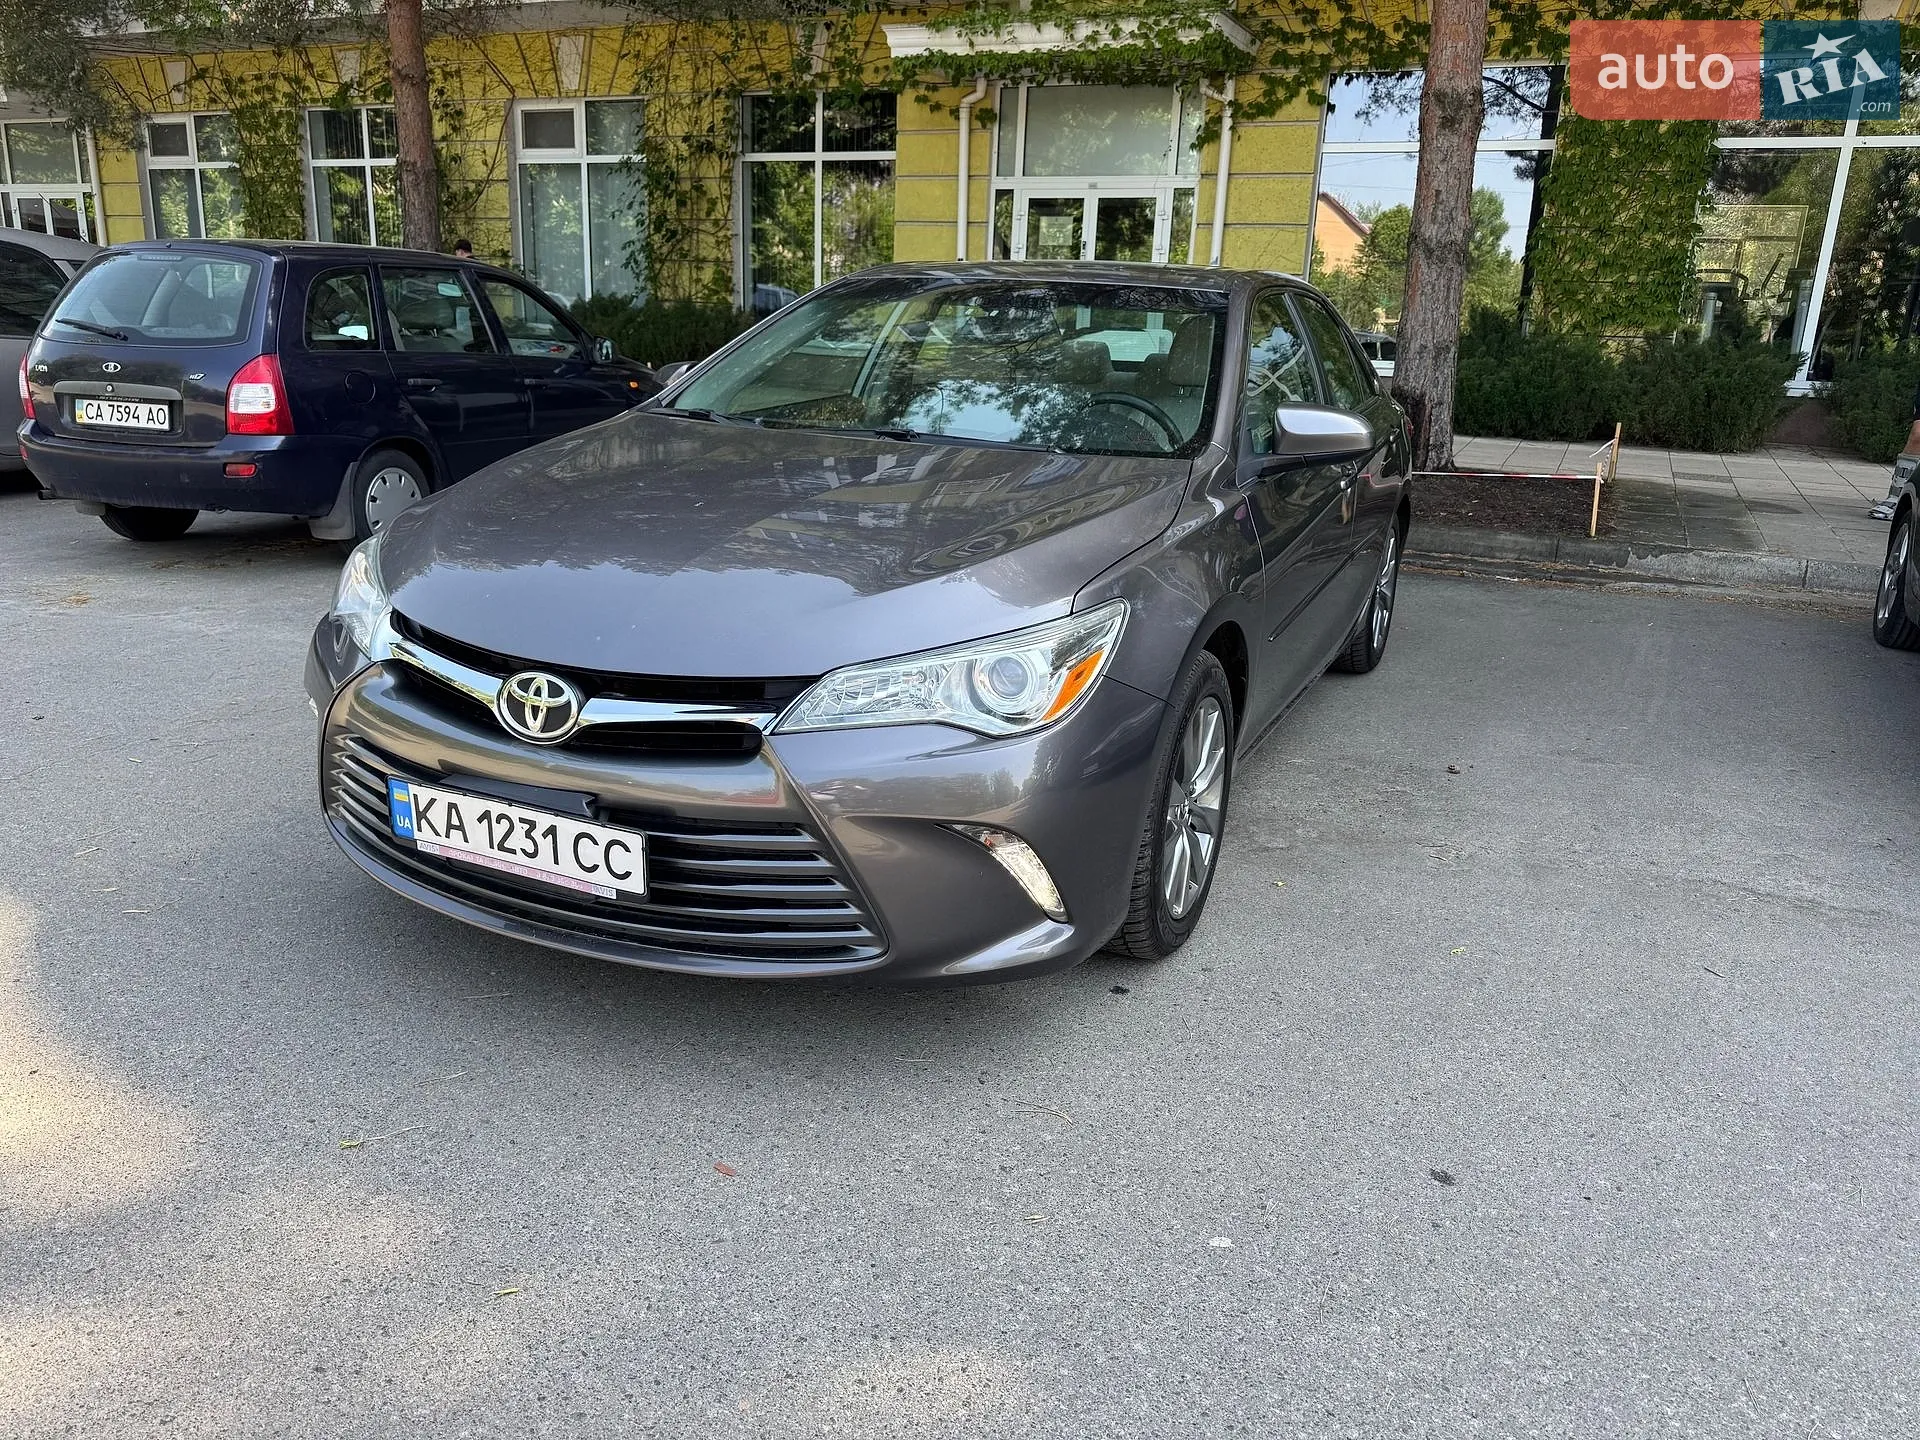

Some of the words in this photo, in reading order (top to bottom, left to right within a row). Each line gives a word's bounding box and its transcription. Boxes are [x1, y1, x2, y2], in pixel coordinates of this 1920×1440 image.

[85, 402, 104, 421] CA
[108, 404, 140, 424] 7594
[146, 406, 167, 425] AO
[396, 815, 412, 830] UA
[413, 793, 470, 844] KA
[476, 809, 560, 866] 1231
[573, 831, 633, 881] CC
